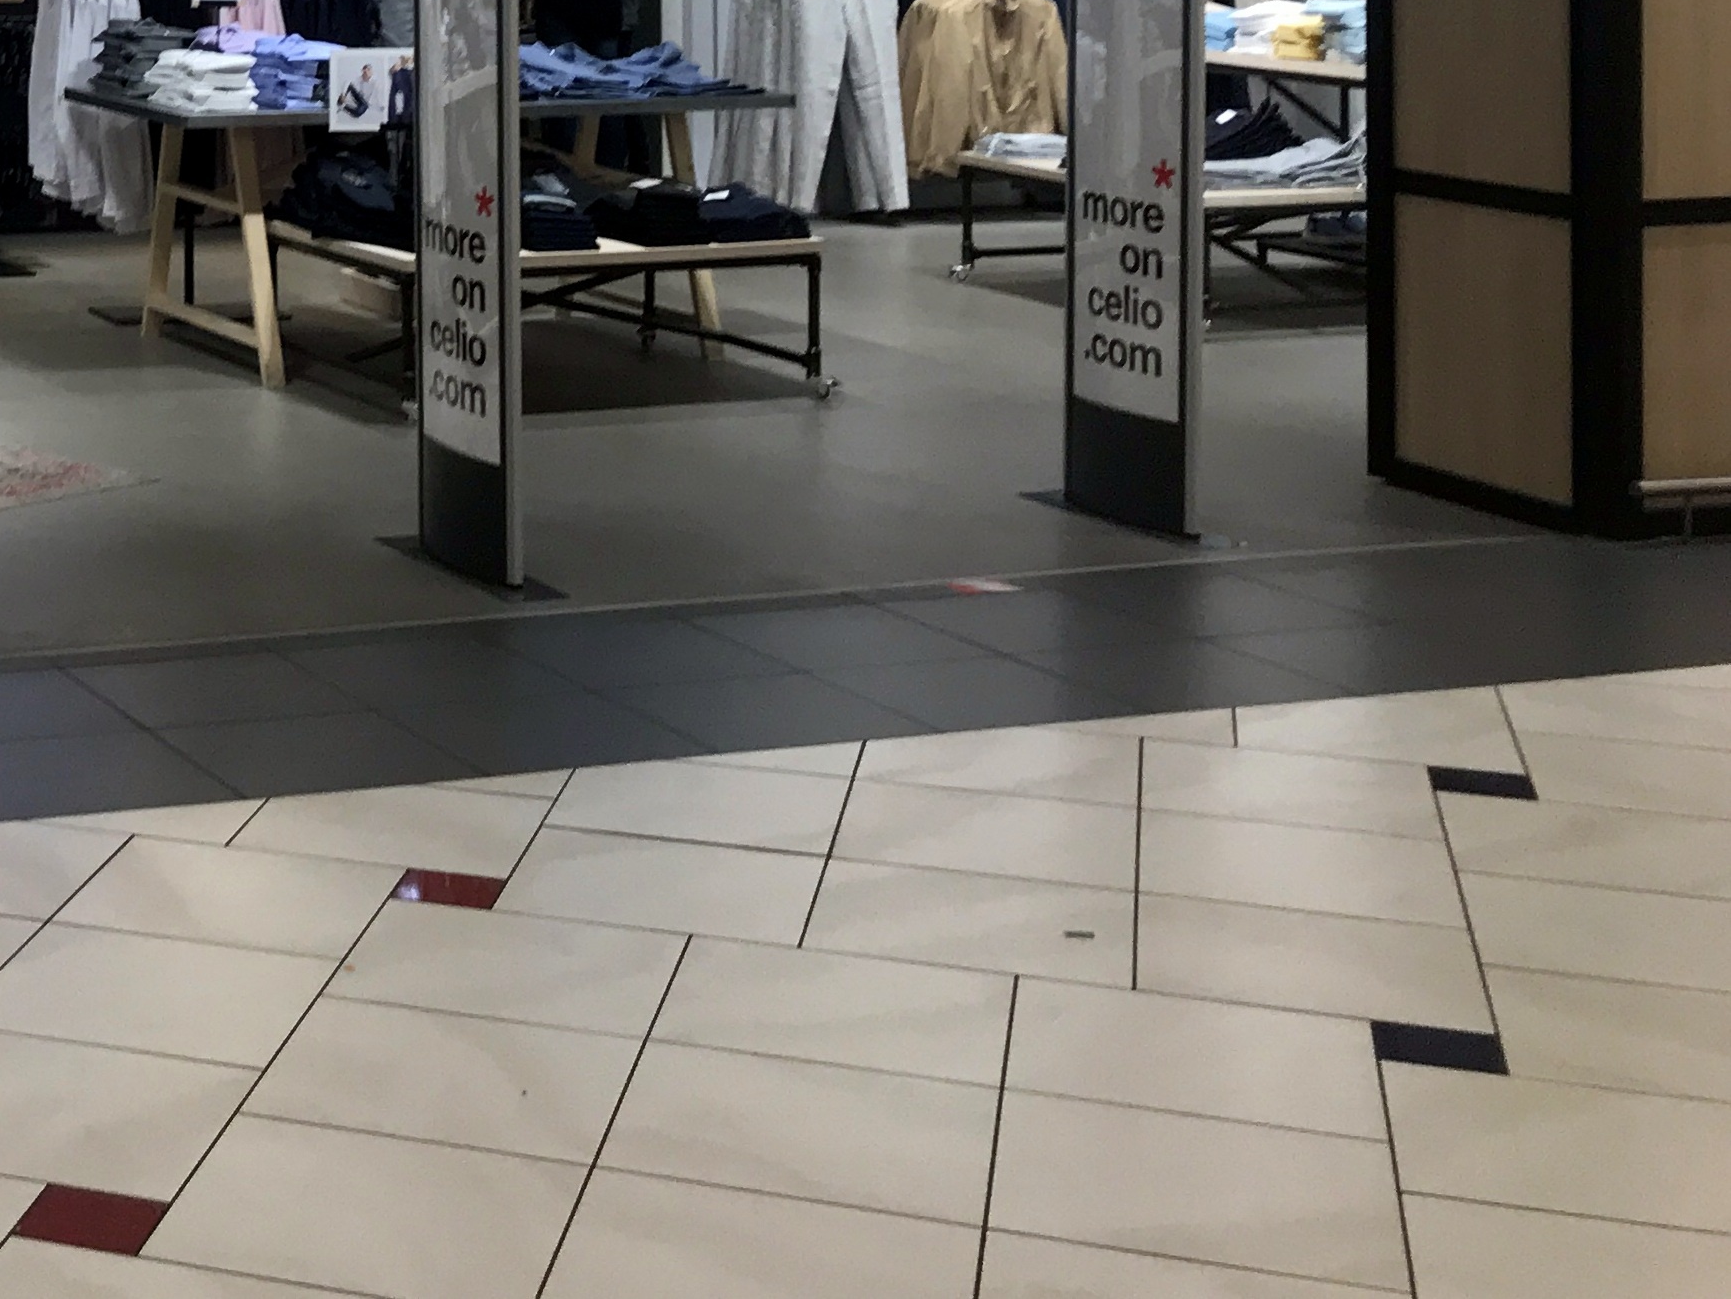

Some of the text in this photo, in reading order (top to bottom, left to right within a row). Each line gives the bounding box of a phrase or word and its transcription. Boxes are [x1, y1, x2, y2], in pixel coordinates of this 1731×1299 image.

[1082, 189, 1165, 234] more
[425, 216, 487, 264] more
[1119, 243, 1163, 280] on
[451, 274, 486, 313] on
[1087, 284, 1163, 330] celio
[430, 317, 487, 366] celio
[1084, 331, 1163, 378] .com
[429, 368, 487, 418] .com
